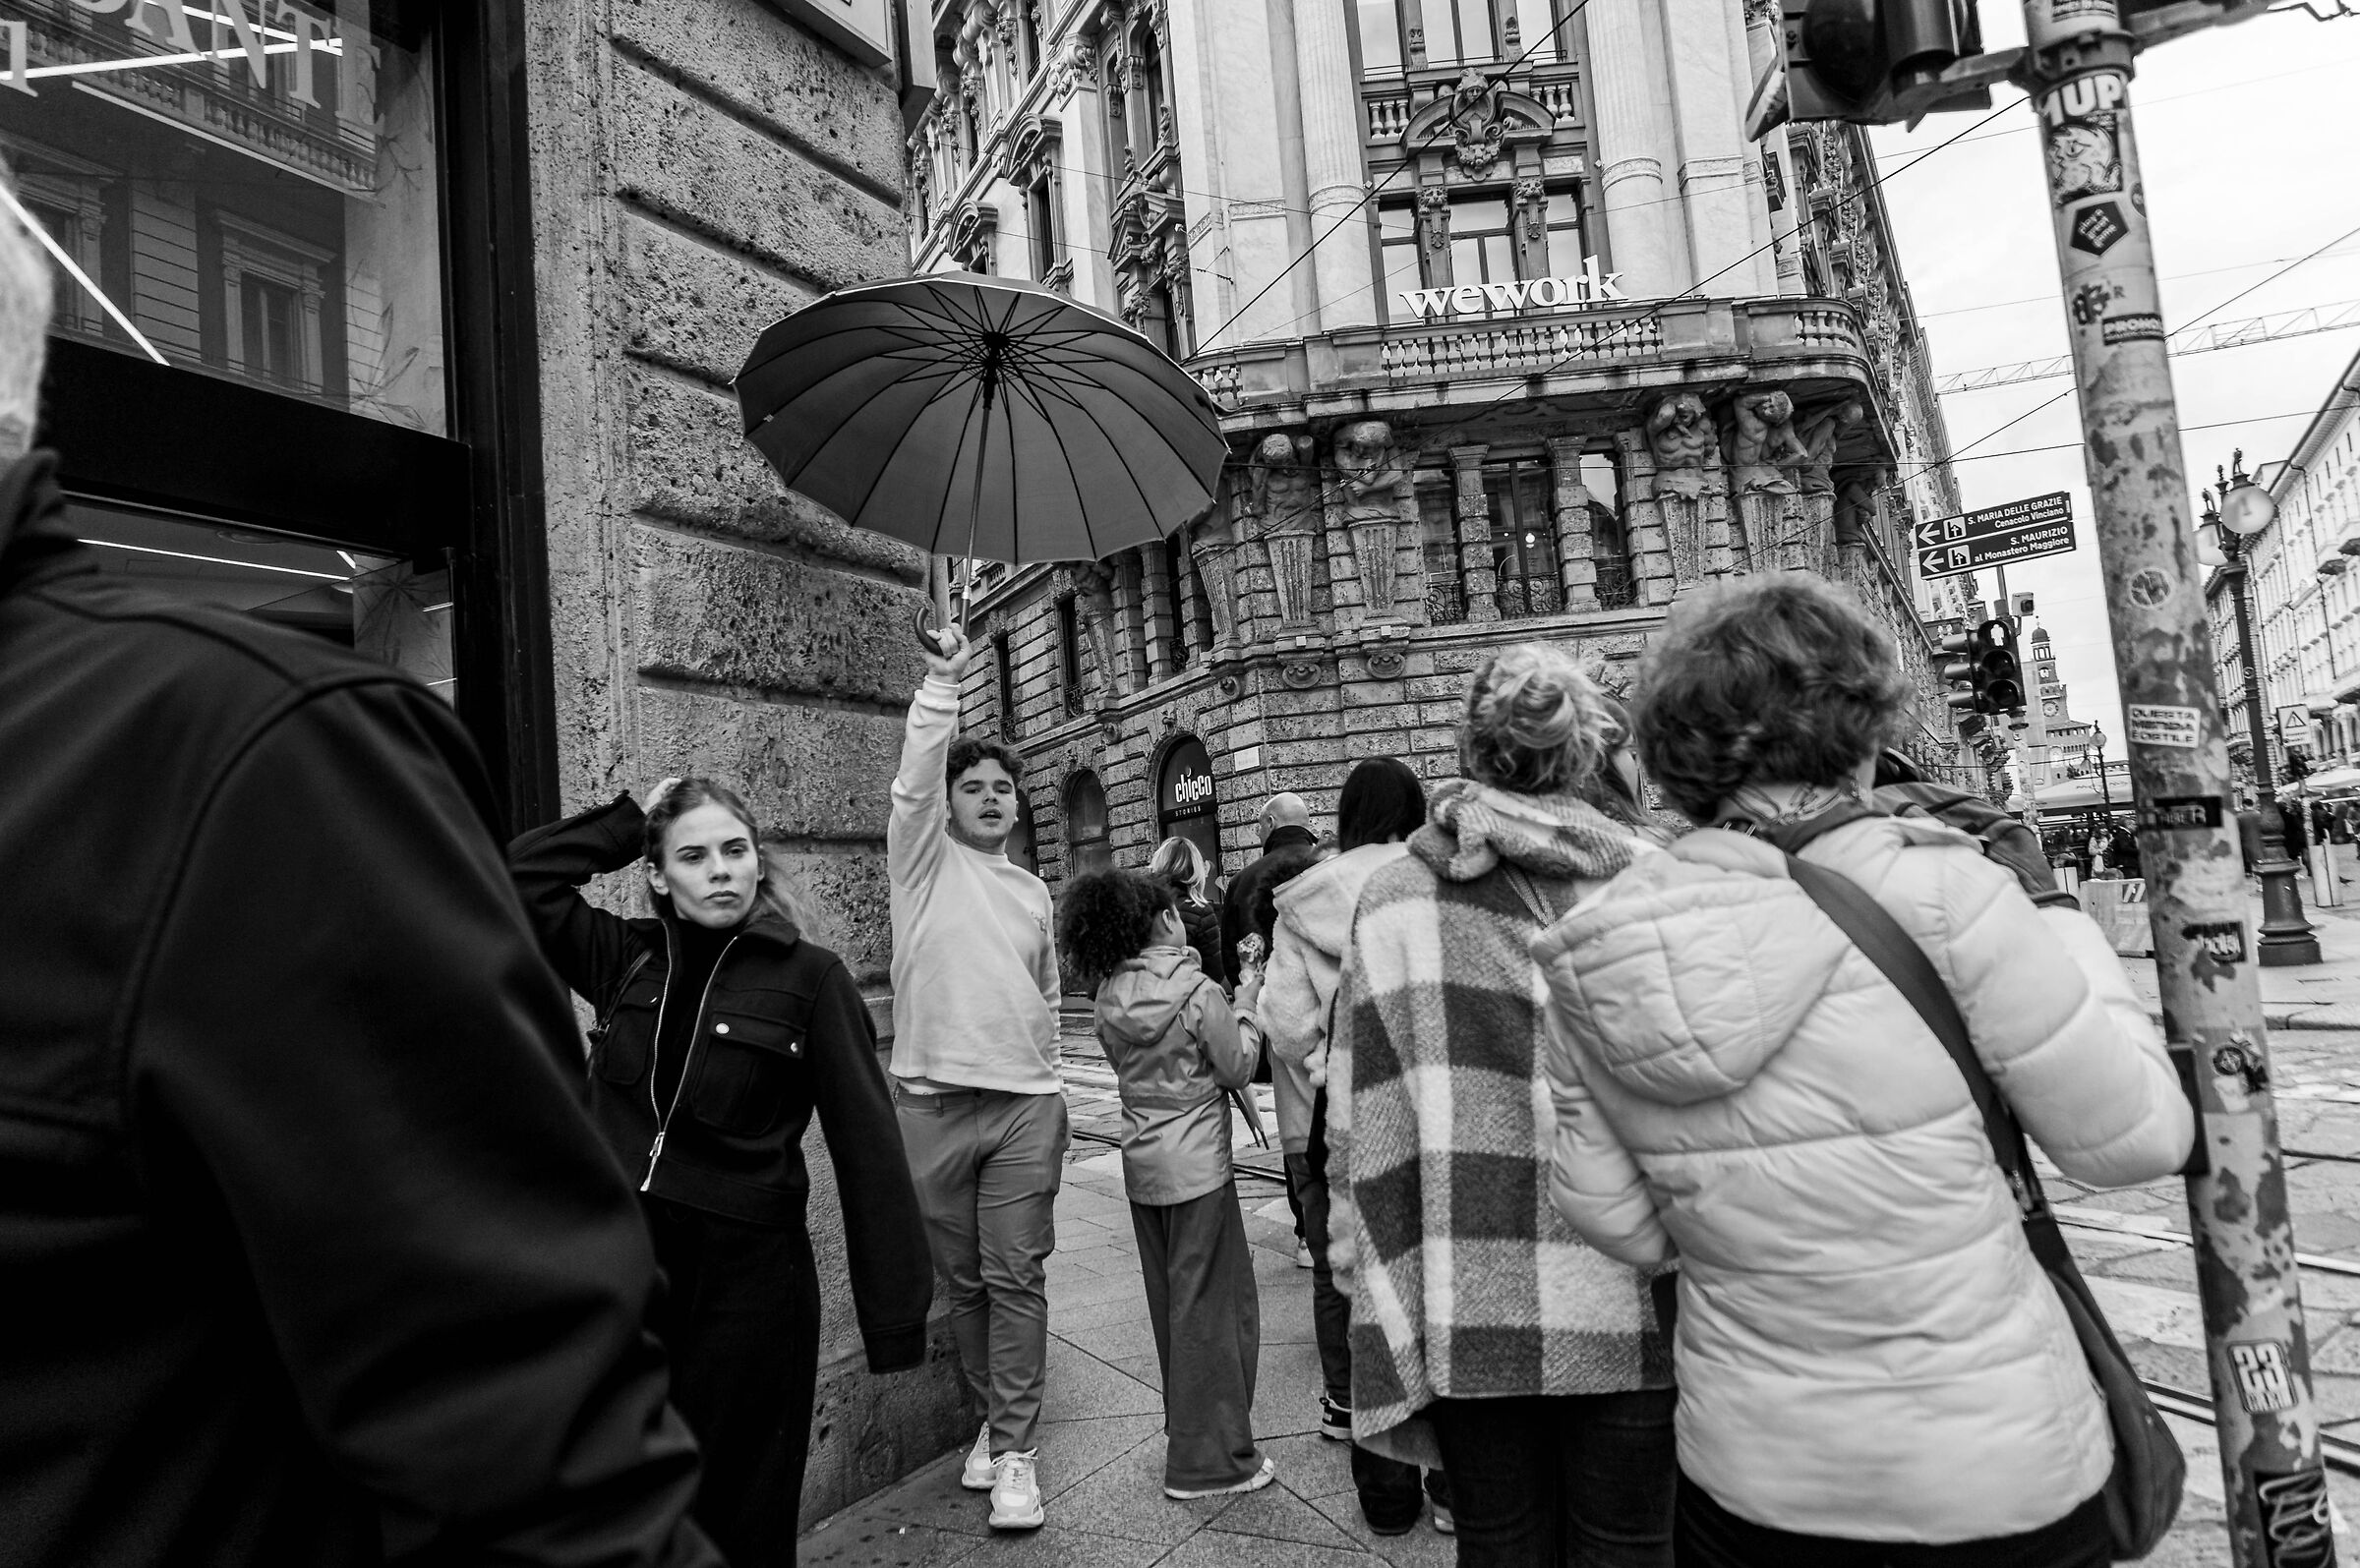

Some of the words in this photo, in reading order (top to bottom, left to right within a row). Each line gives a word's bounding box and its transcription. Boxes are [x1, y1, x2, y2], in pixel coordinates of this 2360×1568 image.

[1399, 255, 1628, 319] wework
[1968, 516, 1976, 525] S.
[1976, 510, 2003, 523] MARIA
[2004, 503, 2030, 517] DELLE
[2031, 495, 2062, 509] GRAZIE
[1995, 516, 2030, 528] Cenacolo
[2031, 506, 2064, 521] Vinciano
[1984, 546, 2028, 560] Monastero
[2031, 537, 2069, 551] Maggiore
[2010, 536, 2019, 546] S.
[2022, 526, 2068, 542] MAURIZIO
[1175, 766, 1212, 803] chicco
